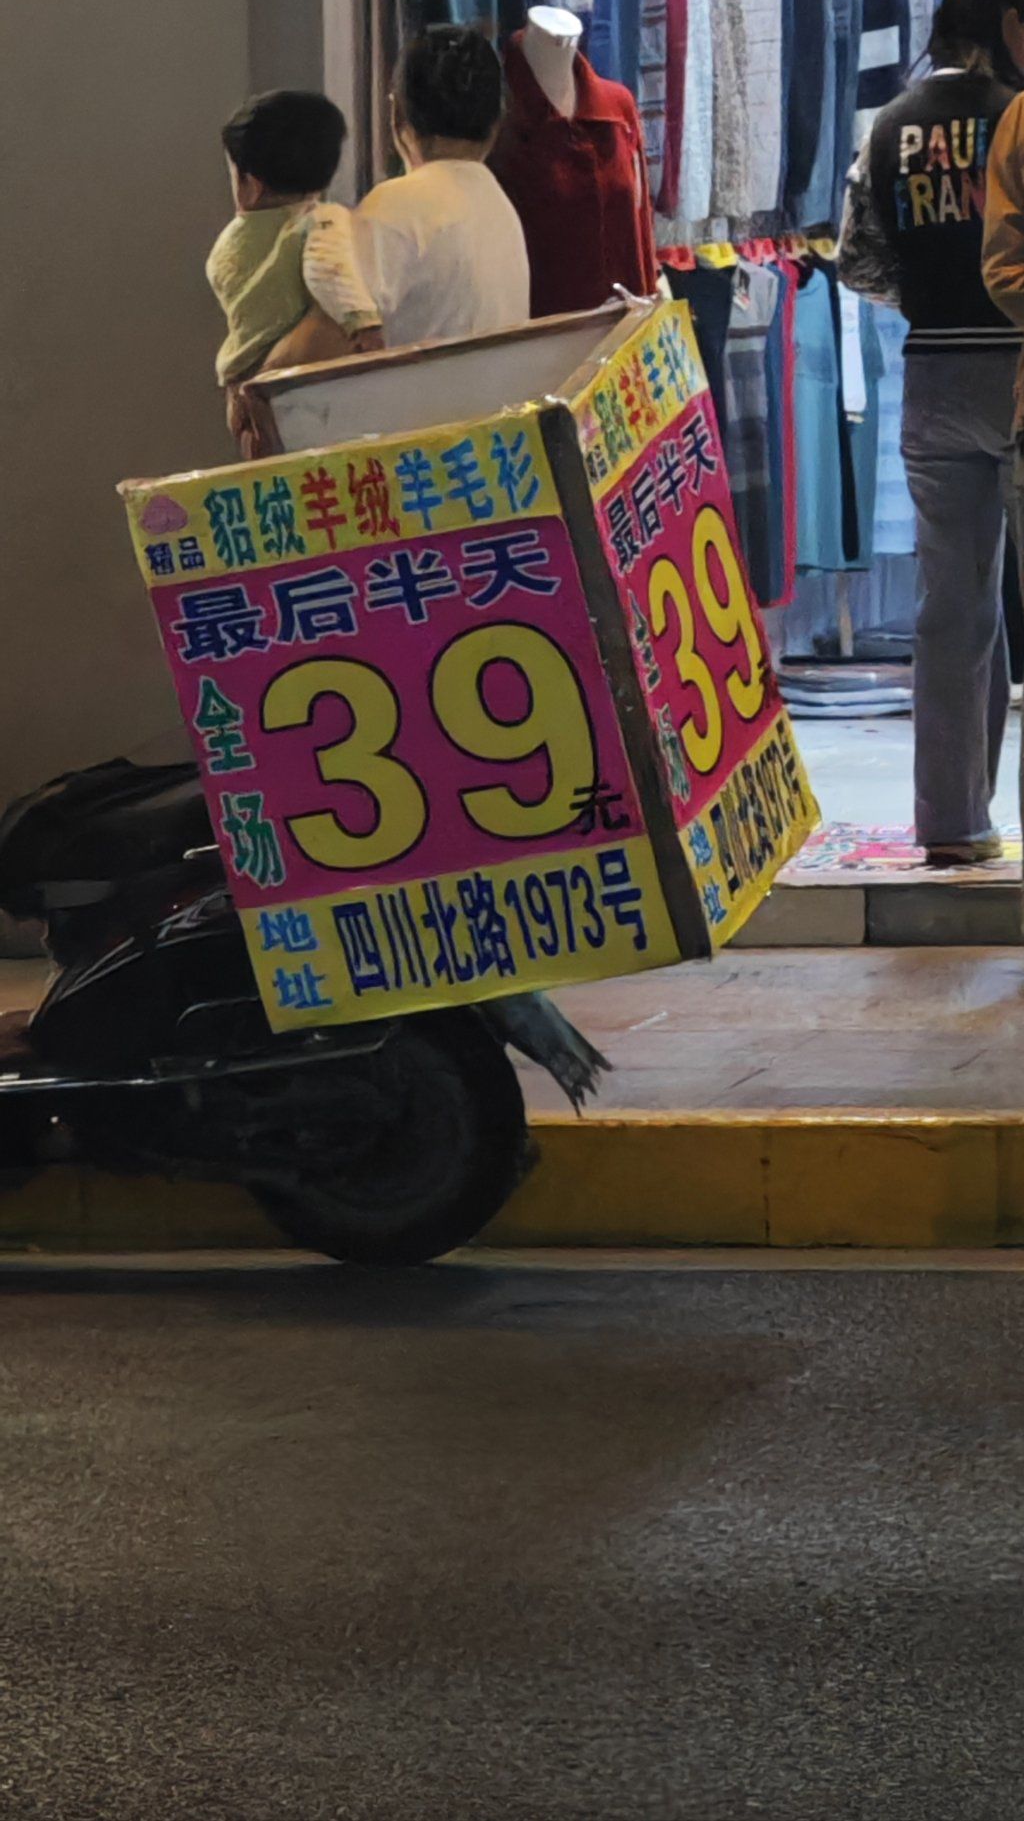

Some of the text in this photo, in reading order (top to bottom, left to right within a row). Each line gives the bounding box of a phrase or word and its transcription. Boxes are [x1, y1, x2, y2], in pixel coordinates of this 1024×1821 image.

[143, 537, 206, 577] 精品
[605, 410, 717, 577] 最后半天
[171, 529, 562, 664] 最后半天
[196, 675, 287, 891] 全场
[255, 905, 332, 1010] 地址
[332, 848, 649, 996] 四川北路1973号
